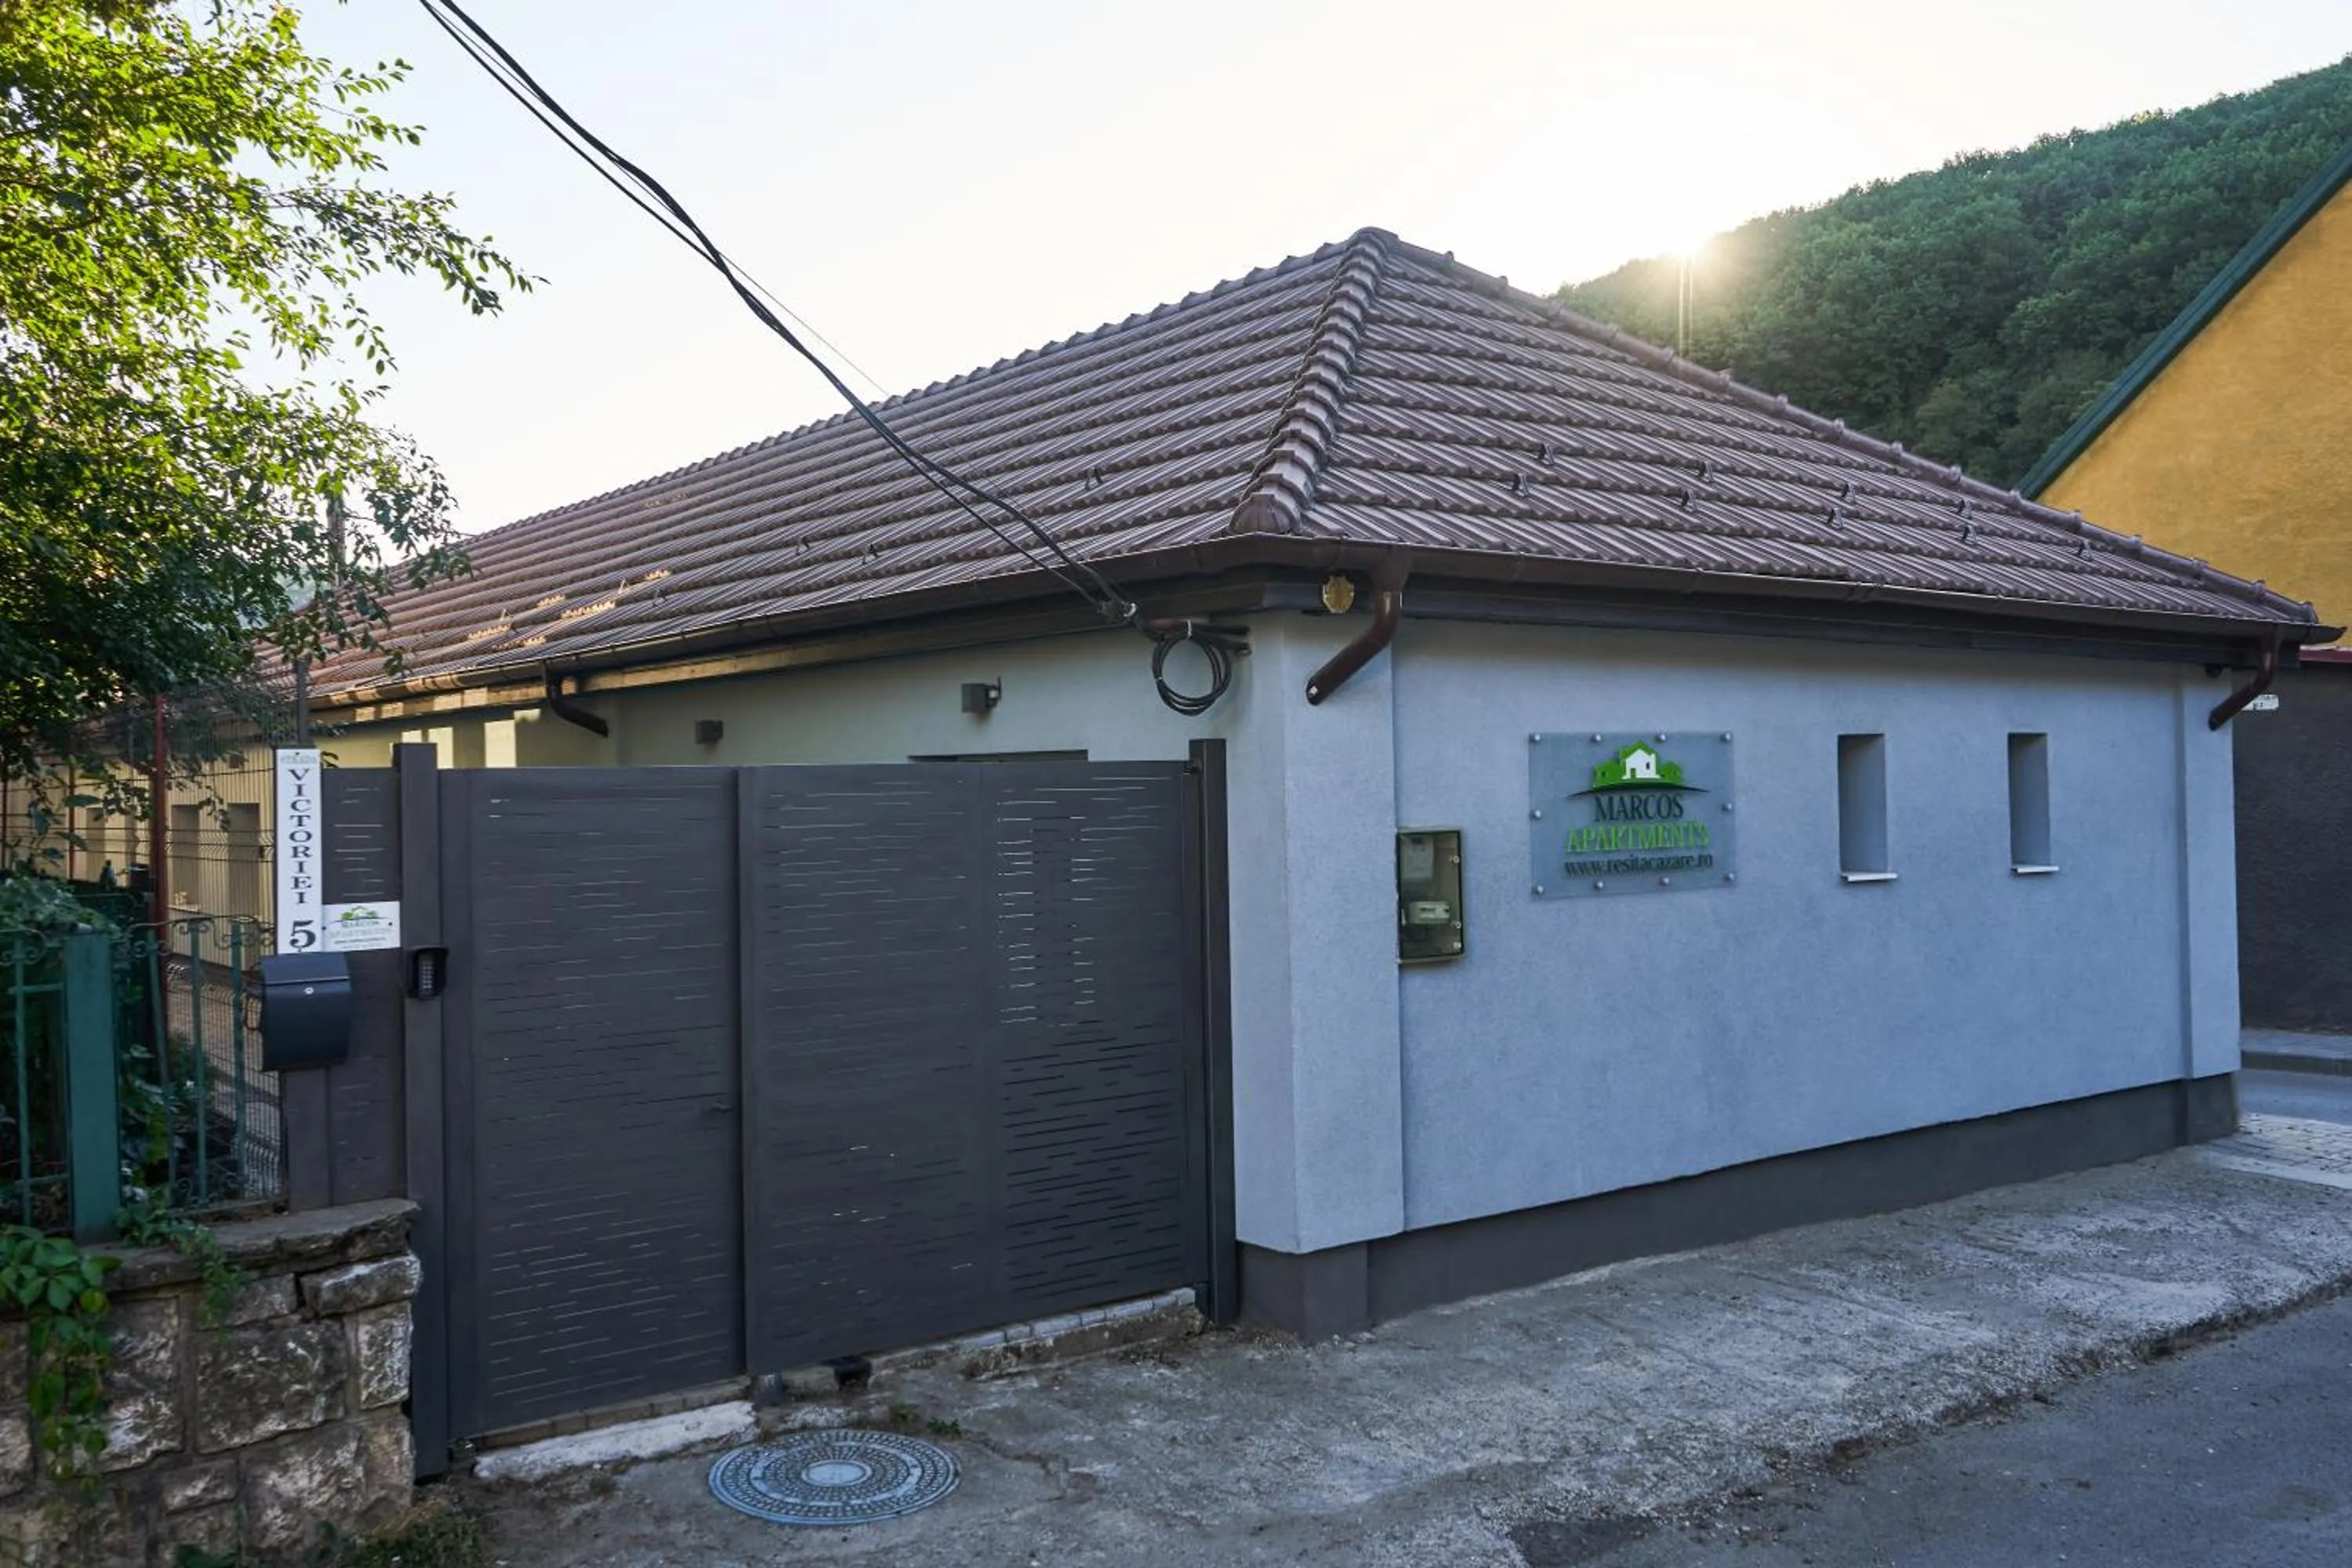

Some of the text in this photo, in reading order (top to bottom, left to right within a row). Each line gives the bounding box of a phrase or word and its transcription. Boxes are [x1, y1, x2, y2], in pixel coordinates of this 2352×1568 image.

[1595, 793, 1684, 822] MARCOS
[289, 768, 313, 903] VICTORIEI
[1566, 822, 1711, 852] APARTMENTS
[289, 920, 316, 949] 5
